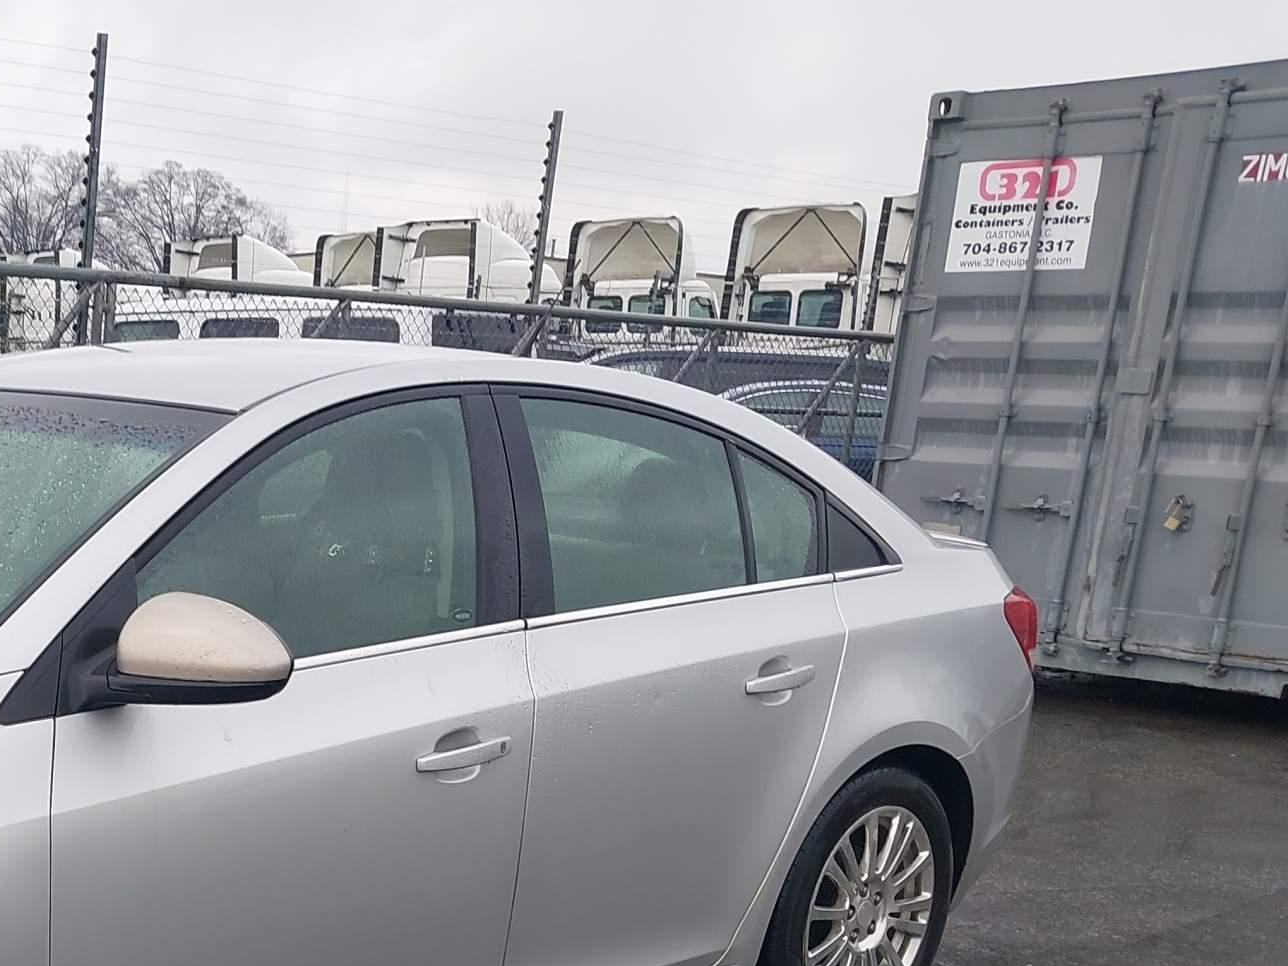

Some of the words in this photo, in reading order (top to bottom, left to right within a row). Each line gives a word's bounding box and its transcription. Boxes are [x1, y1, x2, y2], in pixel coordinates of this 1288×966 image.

[1238, 153, 1288, 182] ZIM
[995, 166, 1059, 201] 321
[1055, 199, 1079, 211] Co.
[954, 217, 1024, 229] Containers
[1042, 214, 1091, 226] railers
[963, 239, 1075, 256] 704-8672317
[959, 256, 1073, 269] www.321equipnt.com
